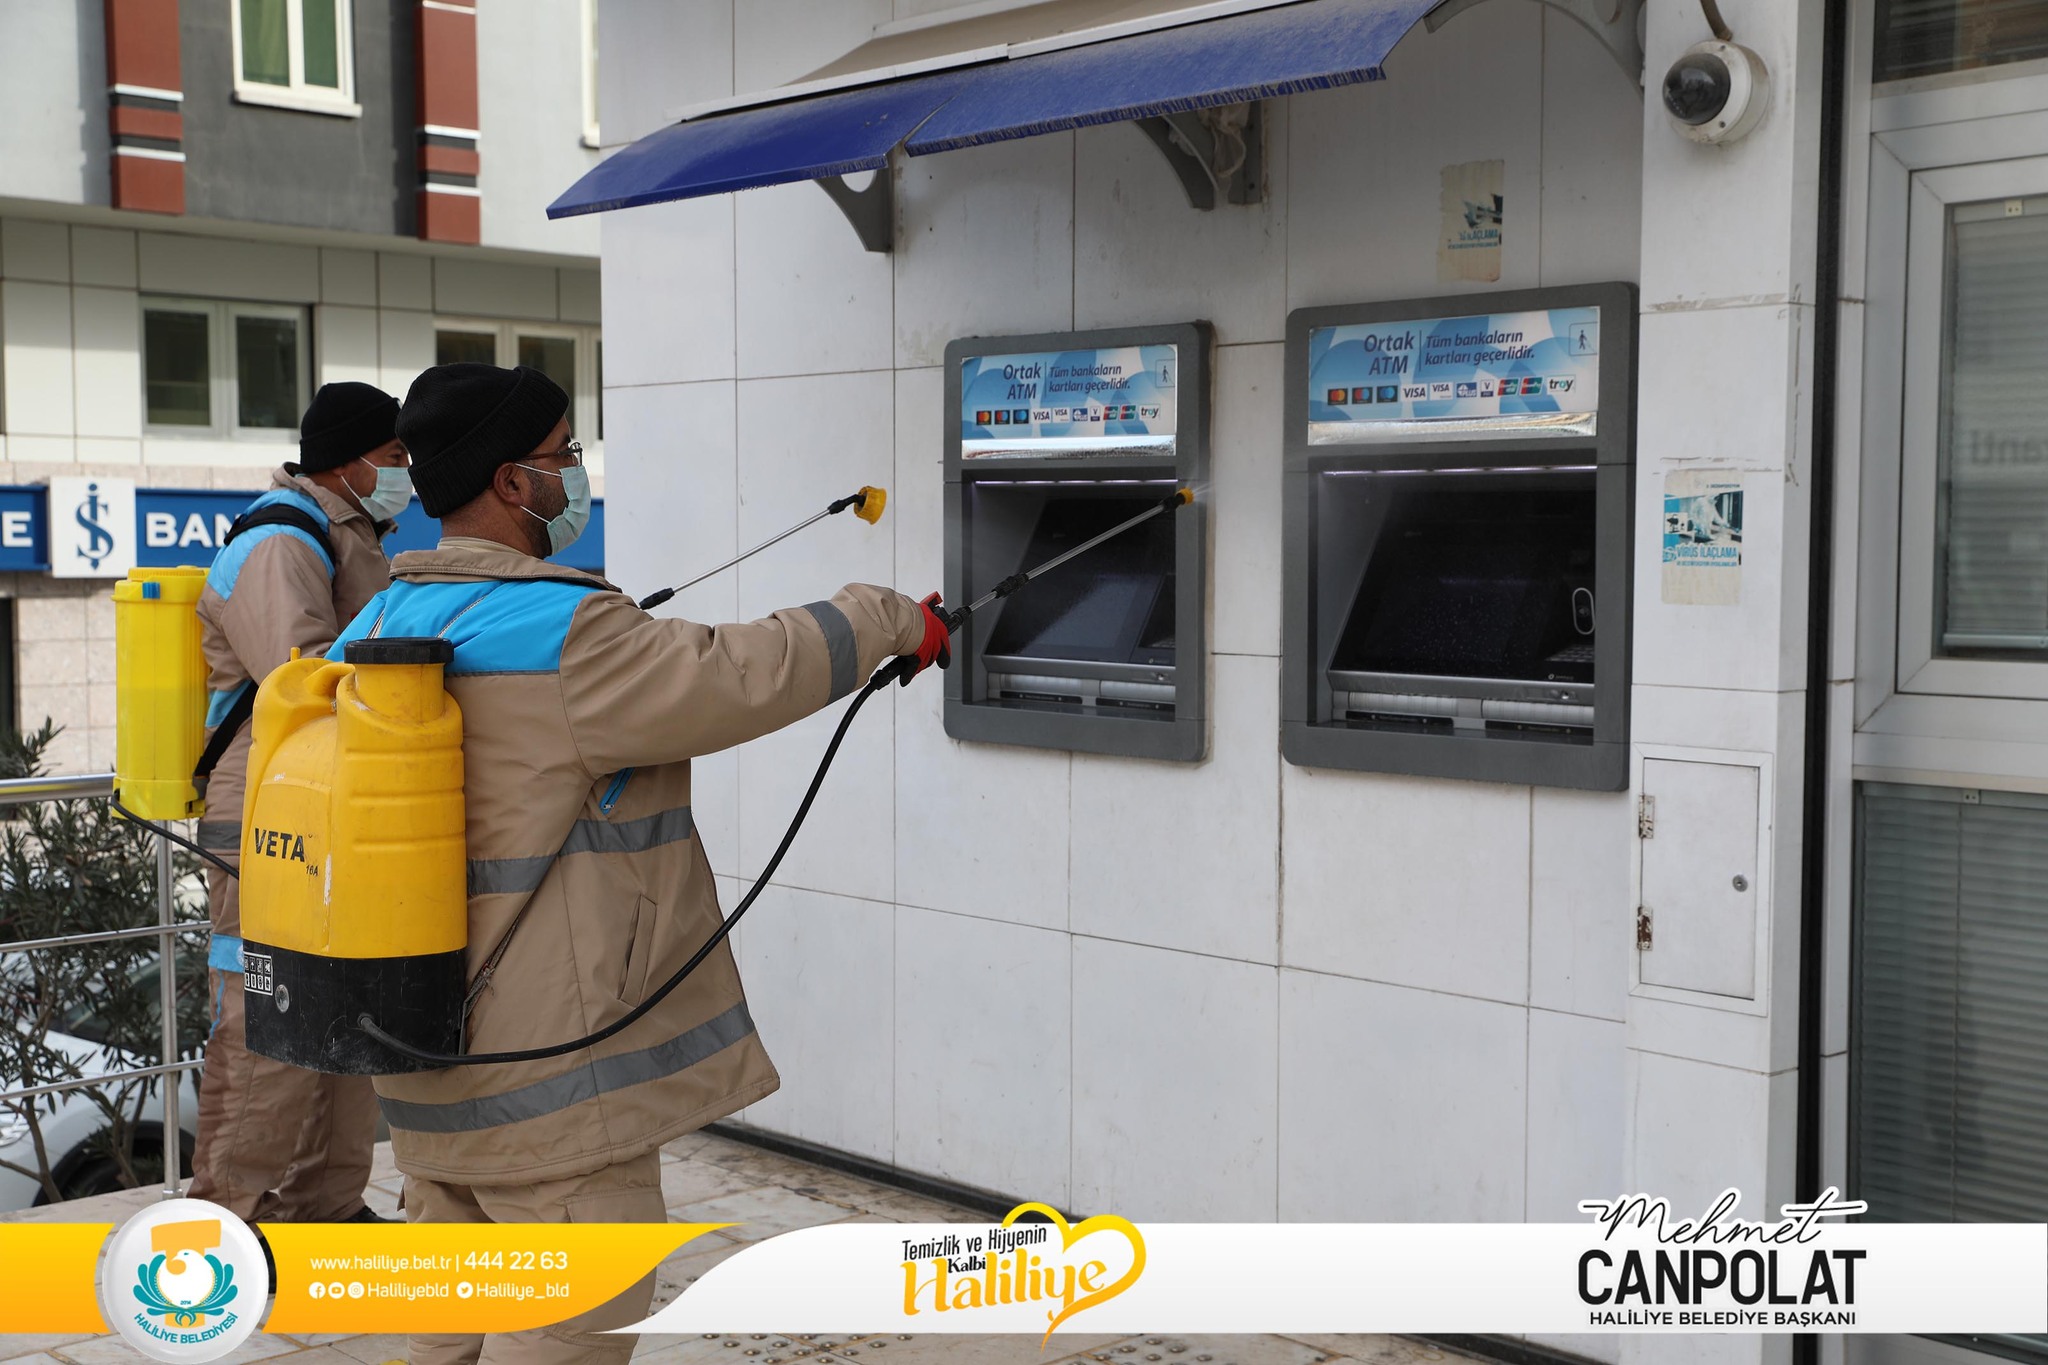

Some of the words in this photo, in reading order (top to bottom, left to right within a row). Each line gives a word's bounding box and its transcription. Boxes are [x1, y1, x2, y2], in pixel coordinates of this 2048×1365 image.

[1364, 330, 1414, 352] Ortak
[1426, 334, 1452, 348] Tüm
[1454, 330, 1523, 347] bankaların
[1368, 355, 1408, 375] ATM
[1425, 351, 1470, 366] kartları
[1473, 347, 1535, 367] geçerlidir.
[1003, 363, 1041, 380] Ortak
[1049, 366, 1069, 378] Tüm
[1071, 363, 1122, 377] bankaların
[1007, 383, 1037, 400] ATM
[1049, 381, 1083, 393] kartları
[1085, 378, 1130, 394] geçerlidir.
[1403, 386, 1426, 399] VISA
[1432, 383, 1450, 393] VISA
[1549, 378, 1574, 392] troy
[1033, 411, 1050, 421] VISA
[1054, 408, 1068, 416] VISA
[1140, 406, 1159, 418] troy
[146, 512, 242, 548] BAN
[254, 827, 305, 862] VETA
